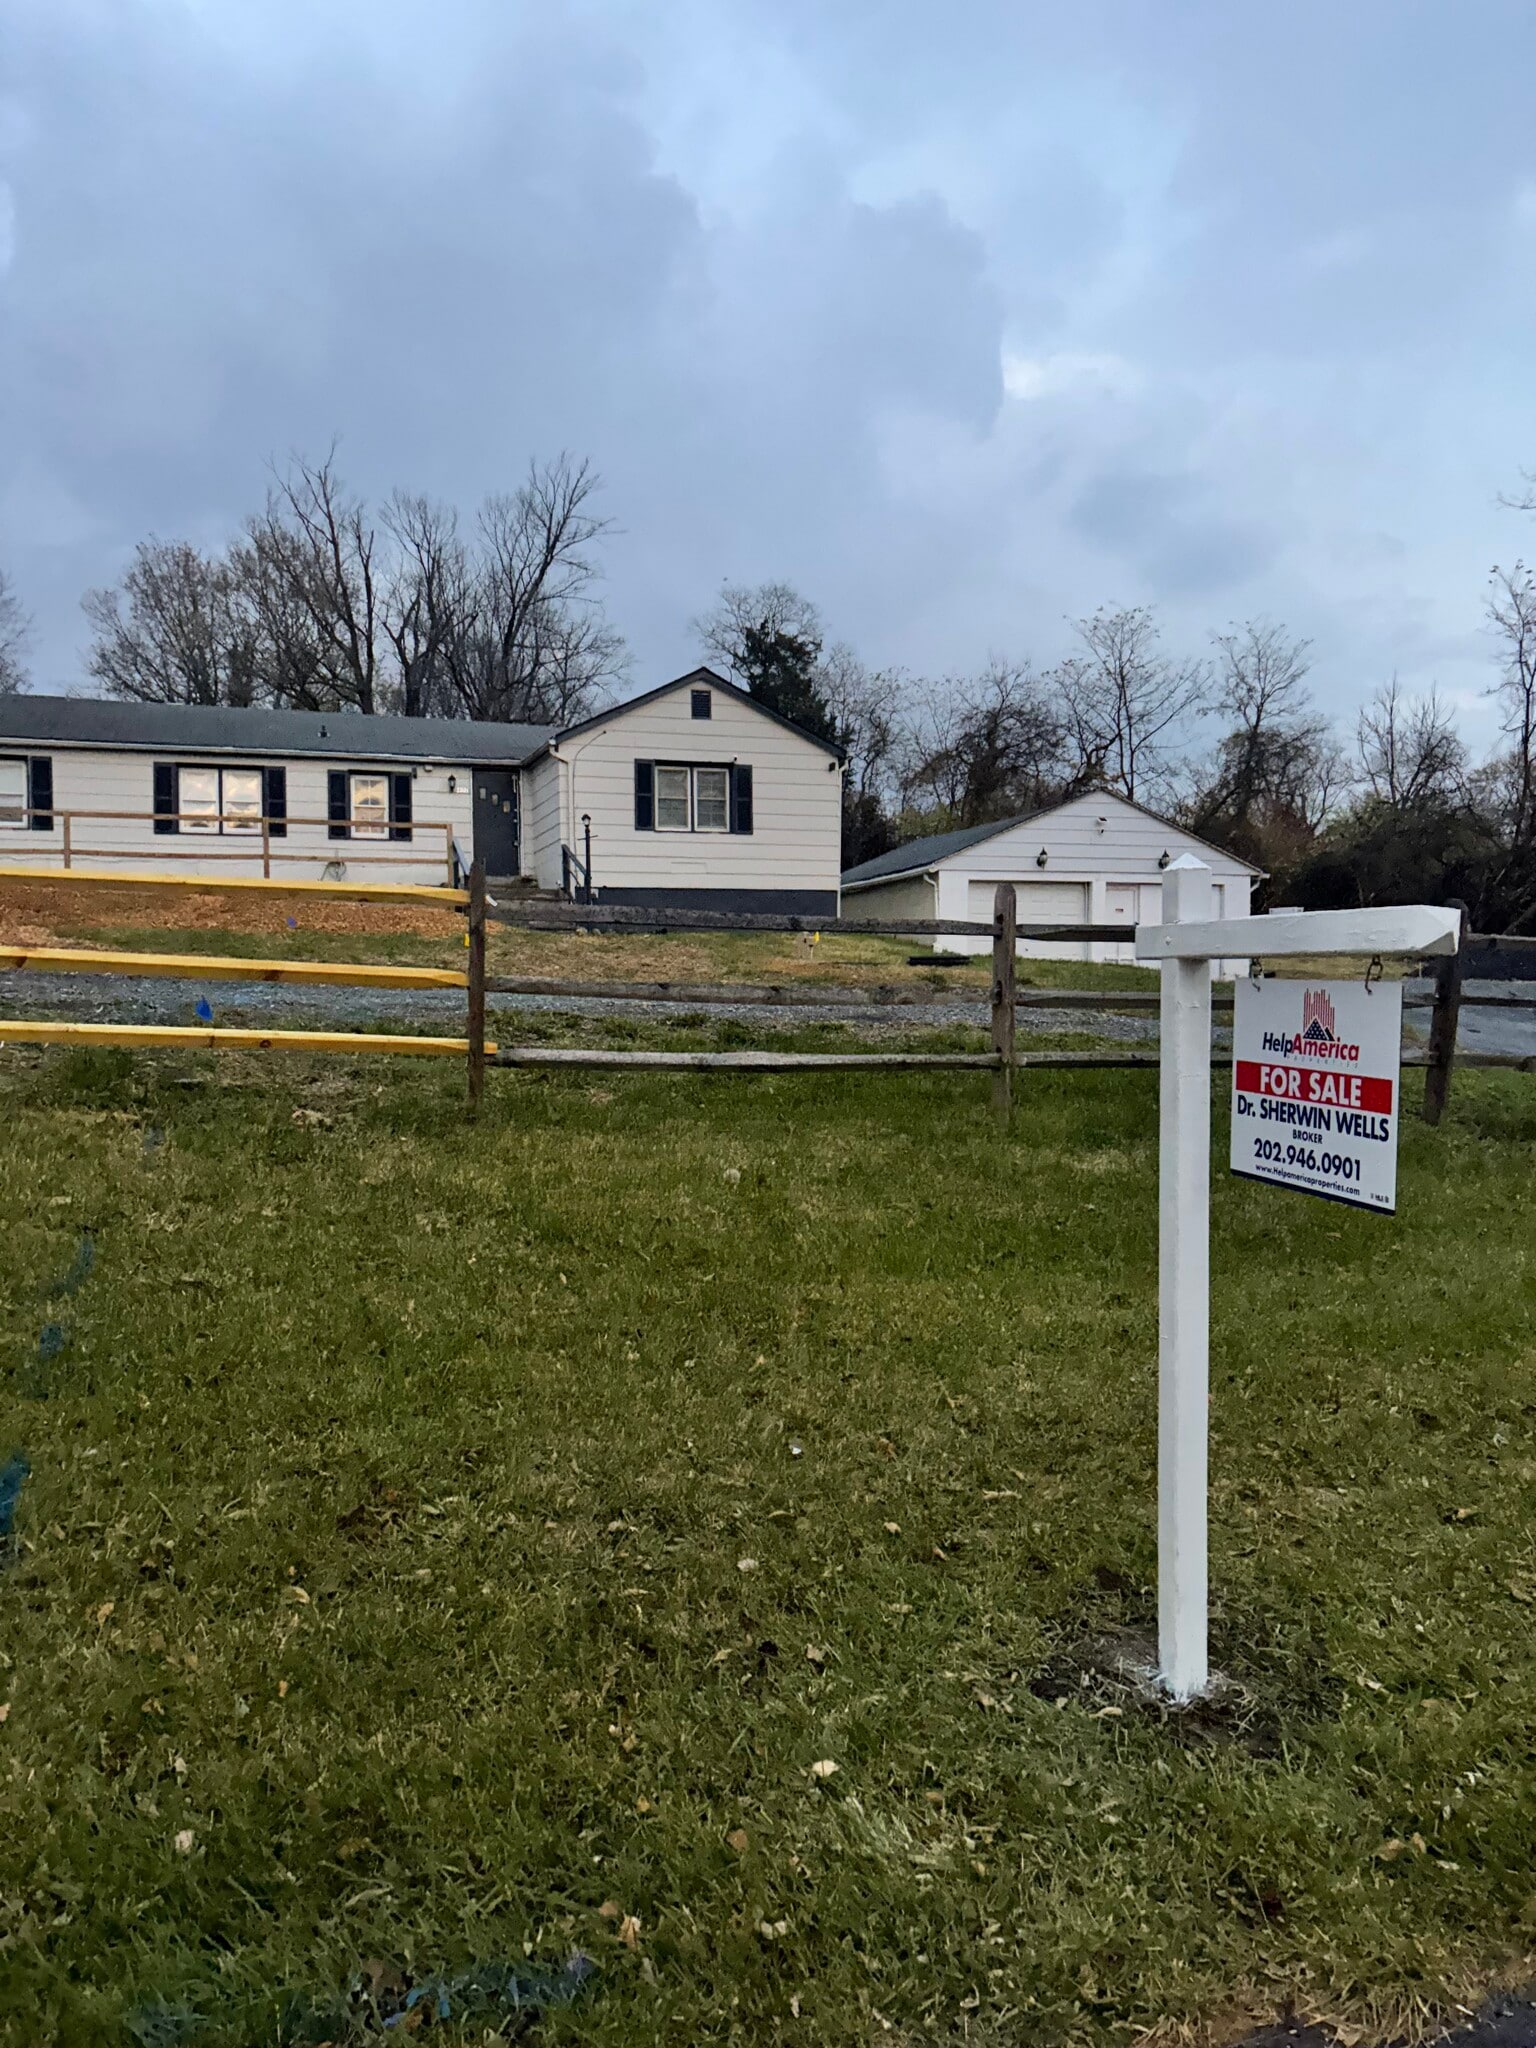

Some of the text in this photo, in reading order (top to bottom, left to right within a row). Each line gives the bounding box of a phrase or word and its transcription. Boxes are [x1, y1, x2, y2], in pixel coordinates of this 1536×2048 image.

[1262, 1032, 1359, 1061] HelpAmerica
[1260, 1066, 1362, 1107] FOR SALE
[1237, 1095, 1390, 1142] Dr. SHERWIN WELLS
[1292, 1129, 1323, 1144] BROKER
[1254, 1138, 1360, 1181] 202.946.0901
